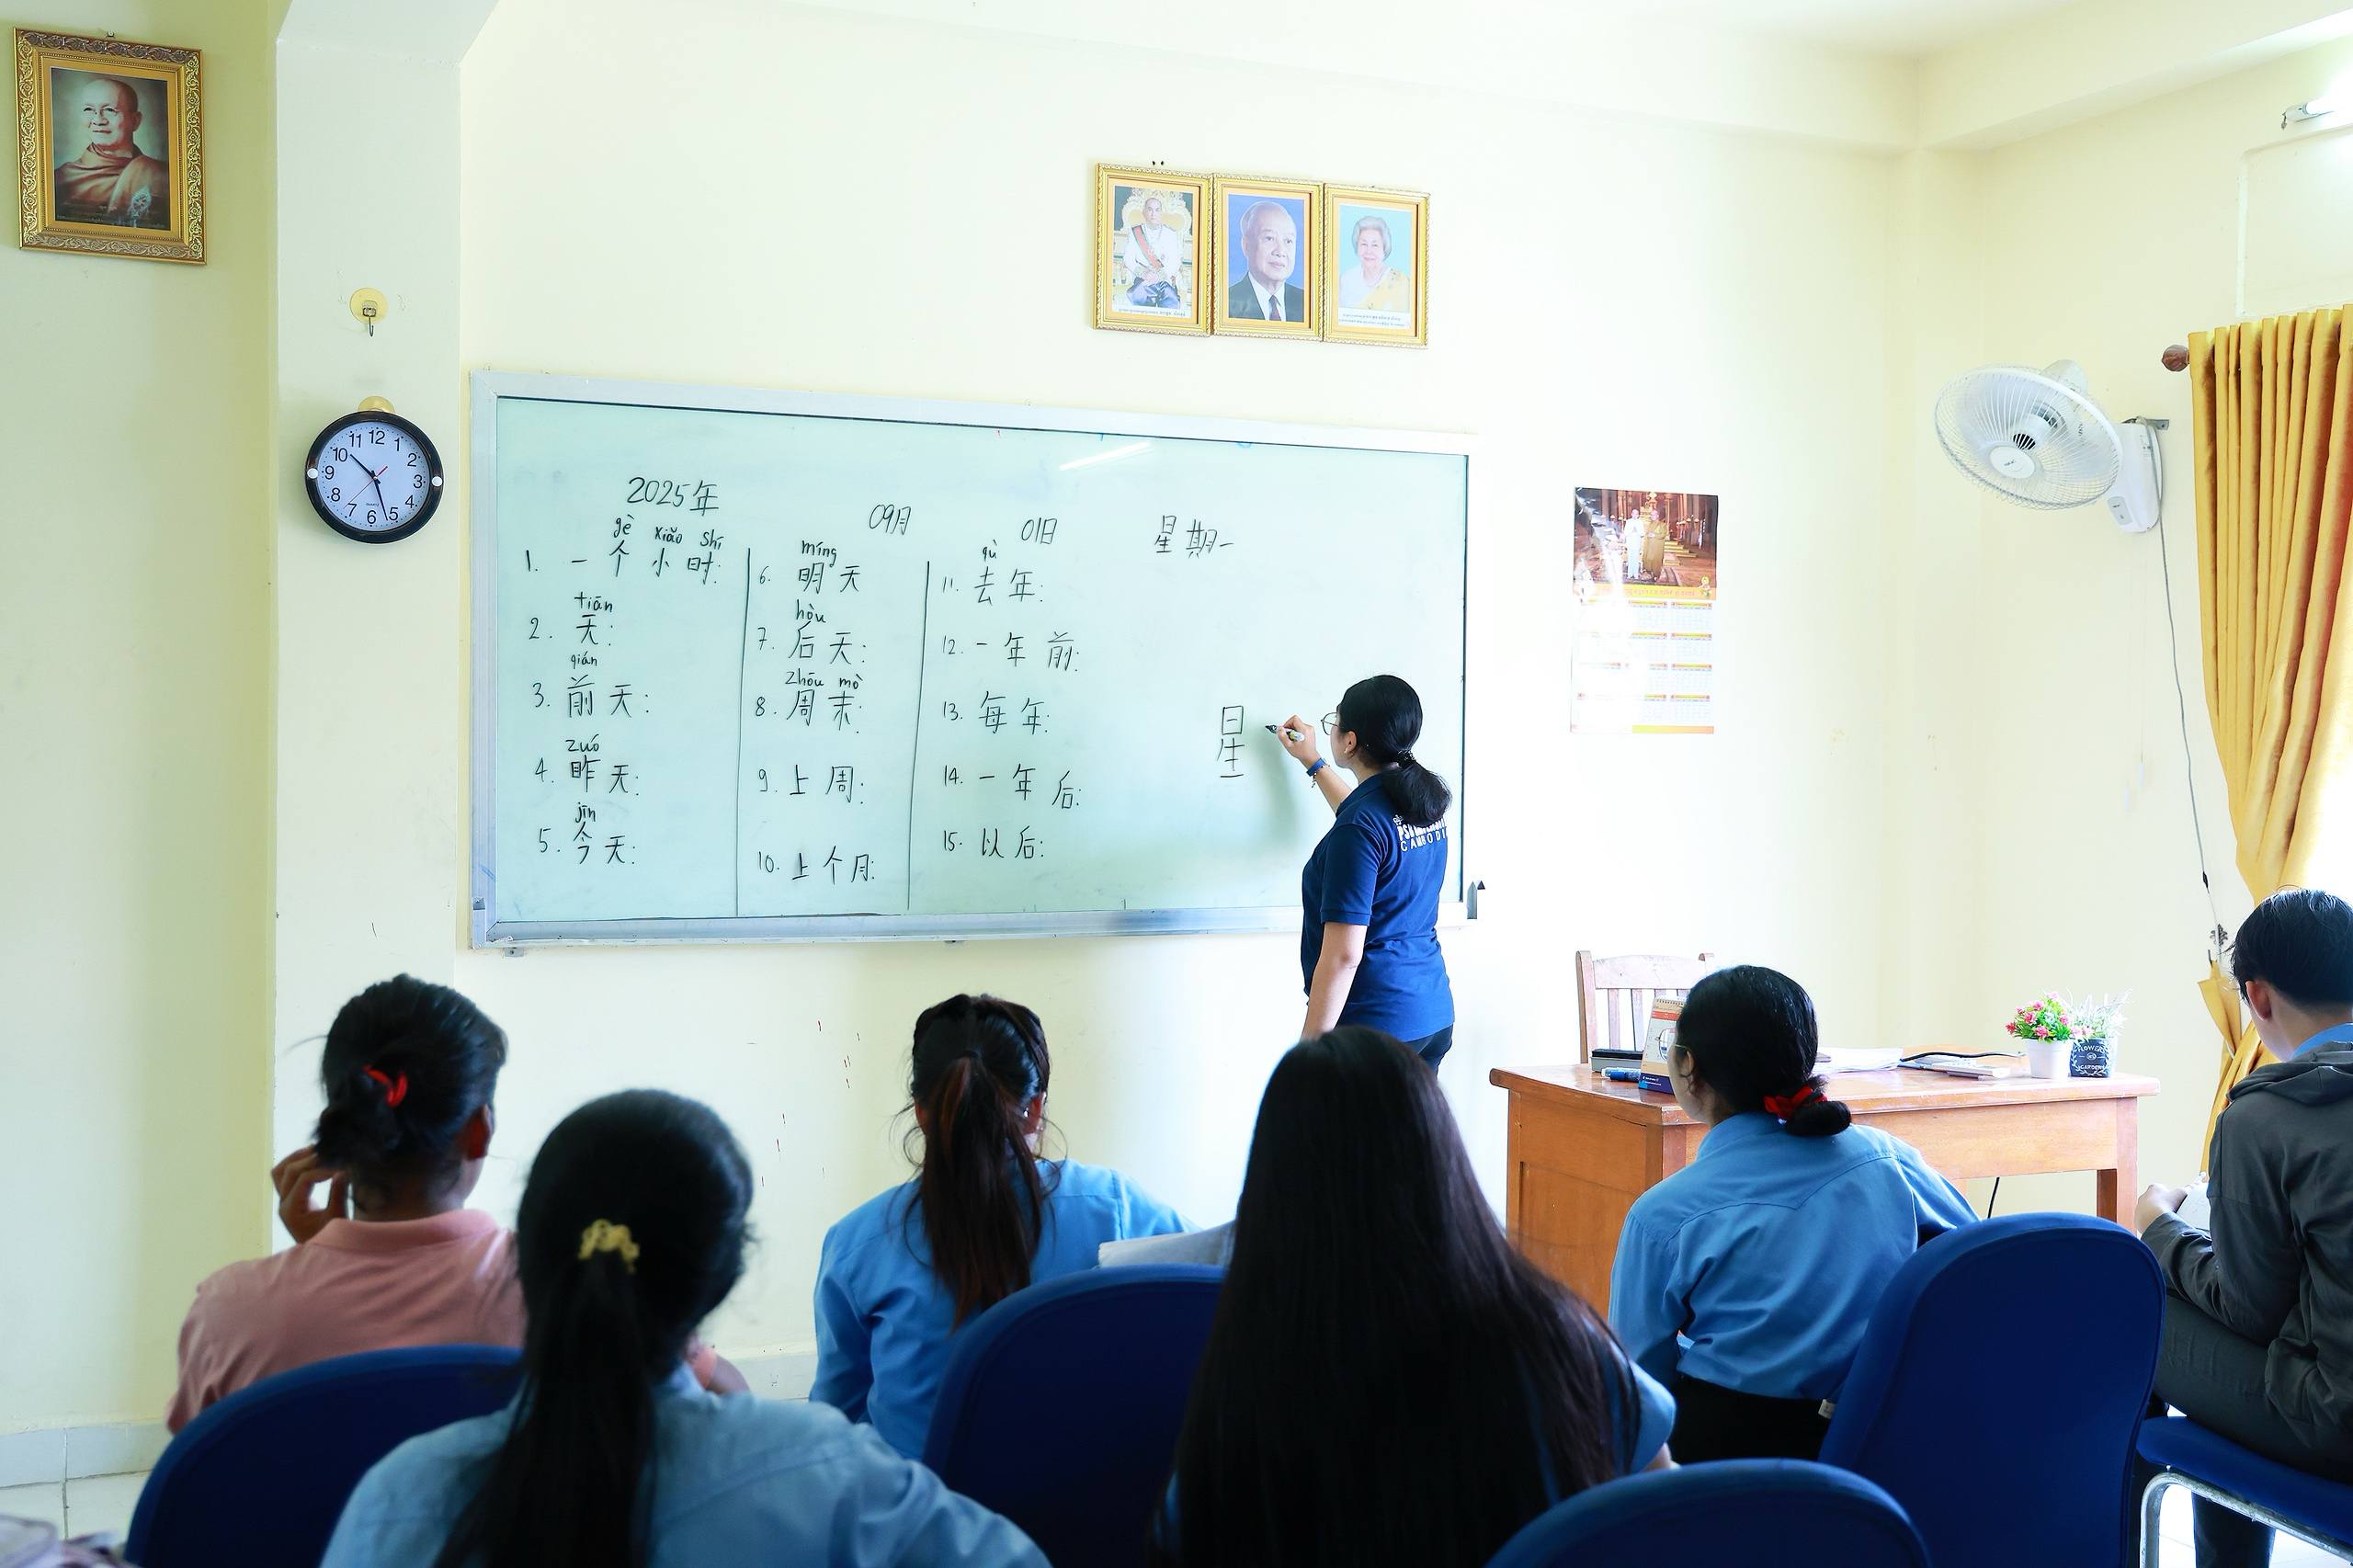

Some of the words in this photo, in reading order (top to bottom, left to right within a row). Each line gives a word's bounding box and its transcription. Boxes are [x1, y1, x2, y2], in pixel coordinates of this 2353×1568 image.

[349, 433, 361, 448] 11
[369, 430, 385, 445] 12
[394, 437, 400, 451] 1
[333, 448, 347, 461] 10
[407, 453, 416, 467] 2
[324, 466, 335, 480] 9
[413, 475, 422, 489] 3
[331, 488, 340, 502] 8
[405, 495, 415, 508] 4
[347, 503, 357, 517] 7
[367, 510, 376, 524] 6
[389, 507, 398, 520] 5
[627, 477, 719, 517] 2025年
[868, 505, 912, 536] 09月
[1021, 517, 1057, 545] 01日
[1154, 515, 1234, 559] 星期一
[613, 514, 634, 538] gè
[526, 550, 539, 572] 1.
[801, 540, 836, 568] míng
[759, 566, 771, 585] 6.
[799, 562, 860, 594] 明天
[943, 576, 959, 593] 11.
[574, 591, 612, 613] tiān
[796, 599, 826, 622] hòu
[529, 618, 553, 640] 2.
[757, 627, 775, 650] 7.
[943, 635, 964, 654] 12.
[839, 673, 863, 689] mò
[533, 683, 551, 708] 3.
[755, 697, 777, 717] 8.
[943, 701, 963, 721] 13.
[565, 734, 600, 753] zuó
[1217, 705, 1245, 778] 星
[535, 757, 554, 783] 4.
[944, 765, 963, 788] 14.
[759, 769, 779, 792] 9.
[539, 828, 560, 853] 5.
[944, 830, 963, 851] 15.
[1401, 828, 1449, 852] CAMBODI
[757, 851, 779, 873] 10.
